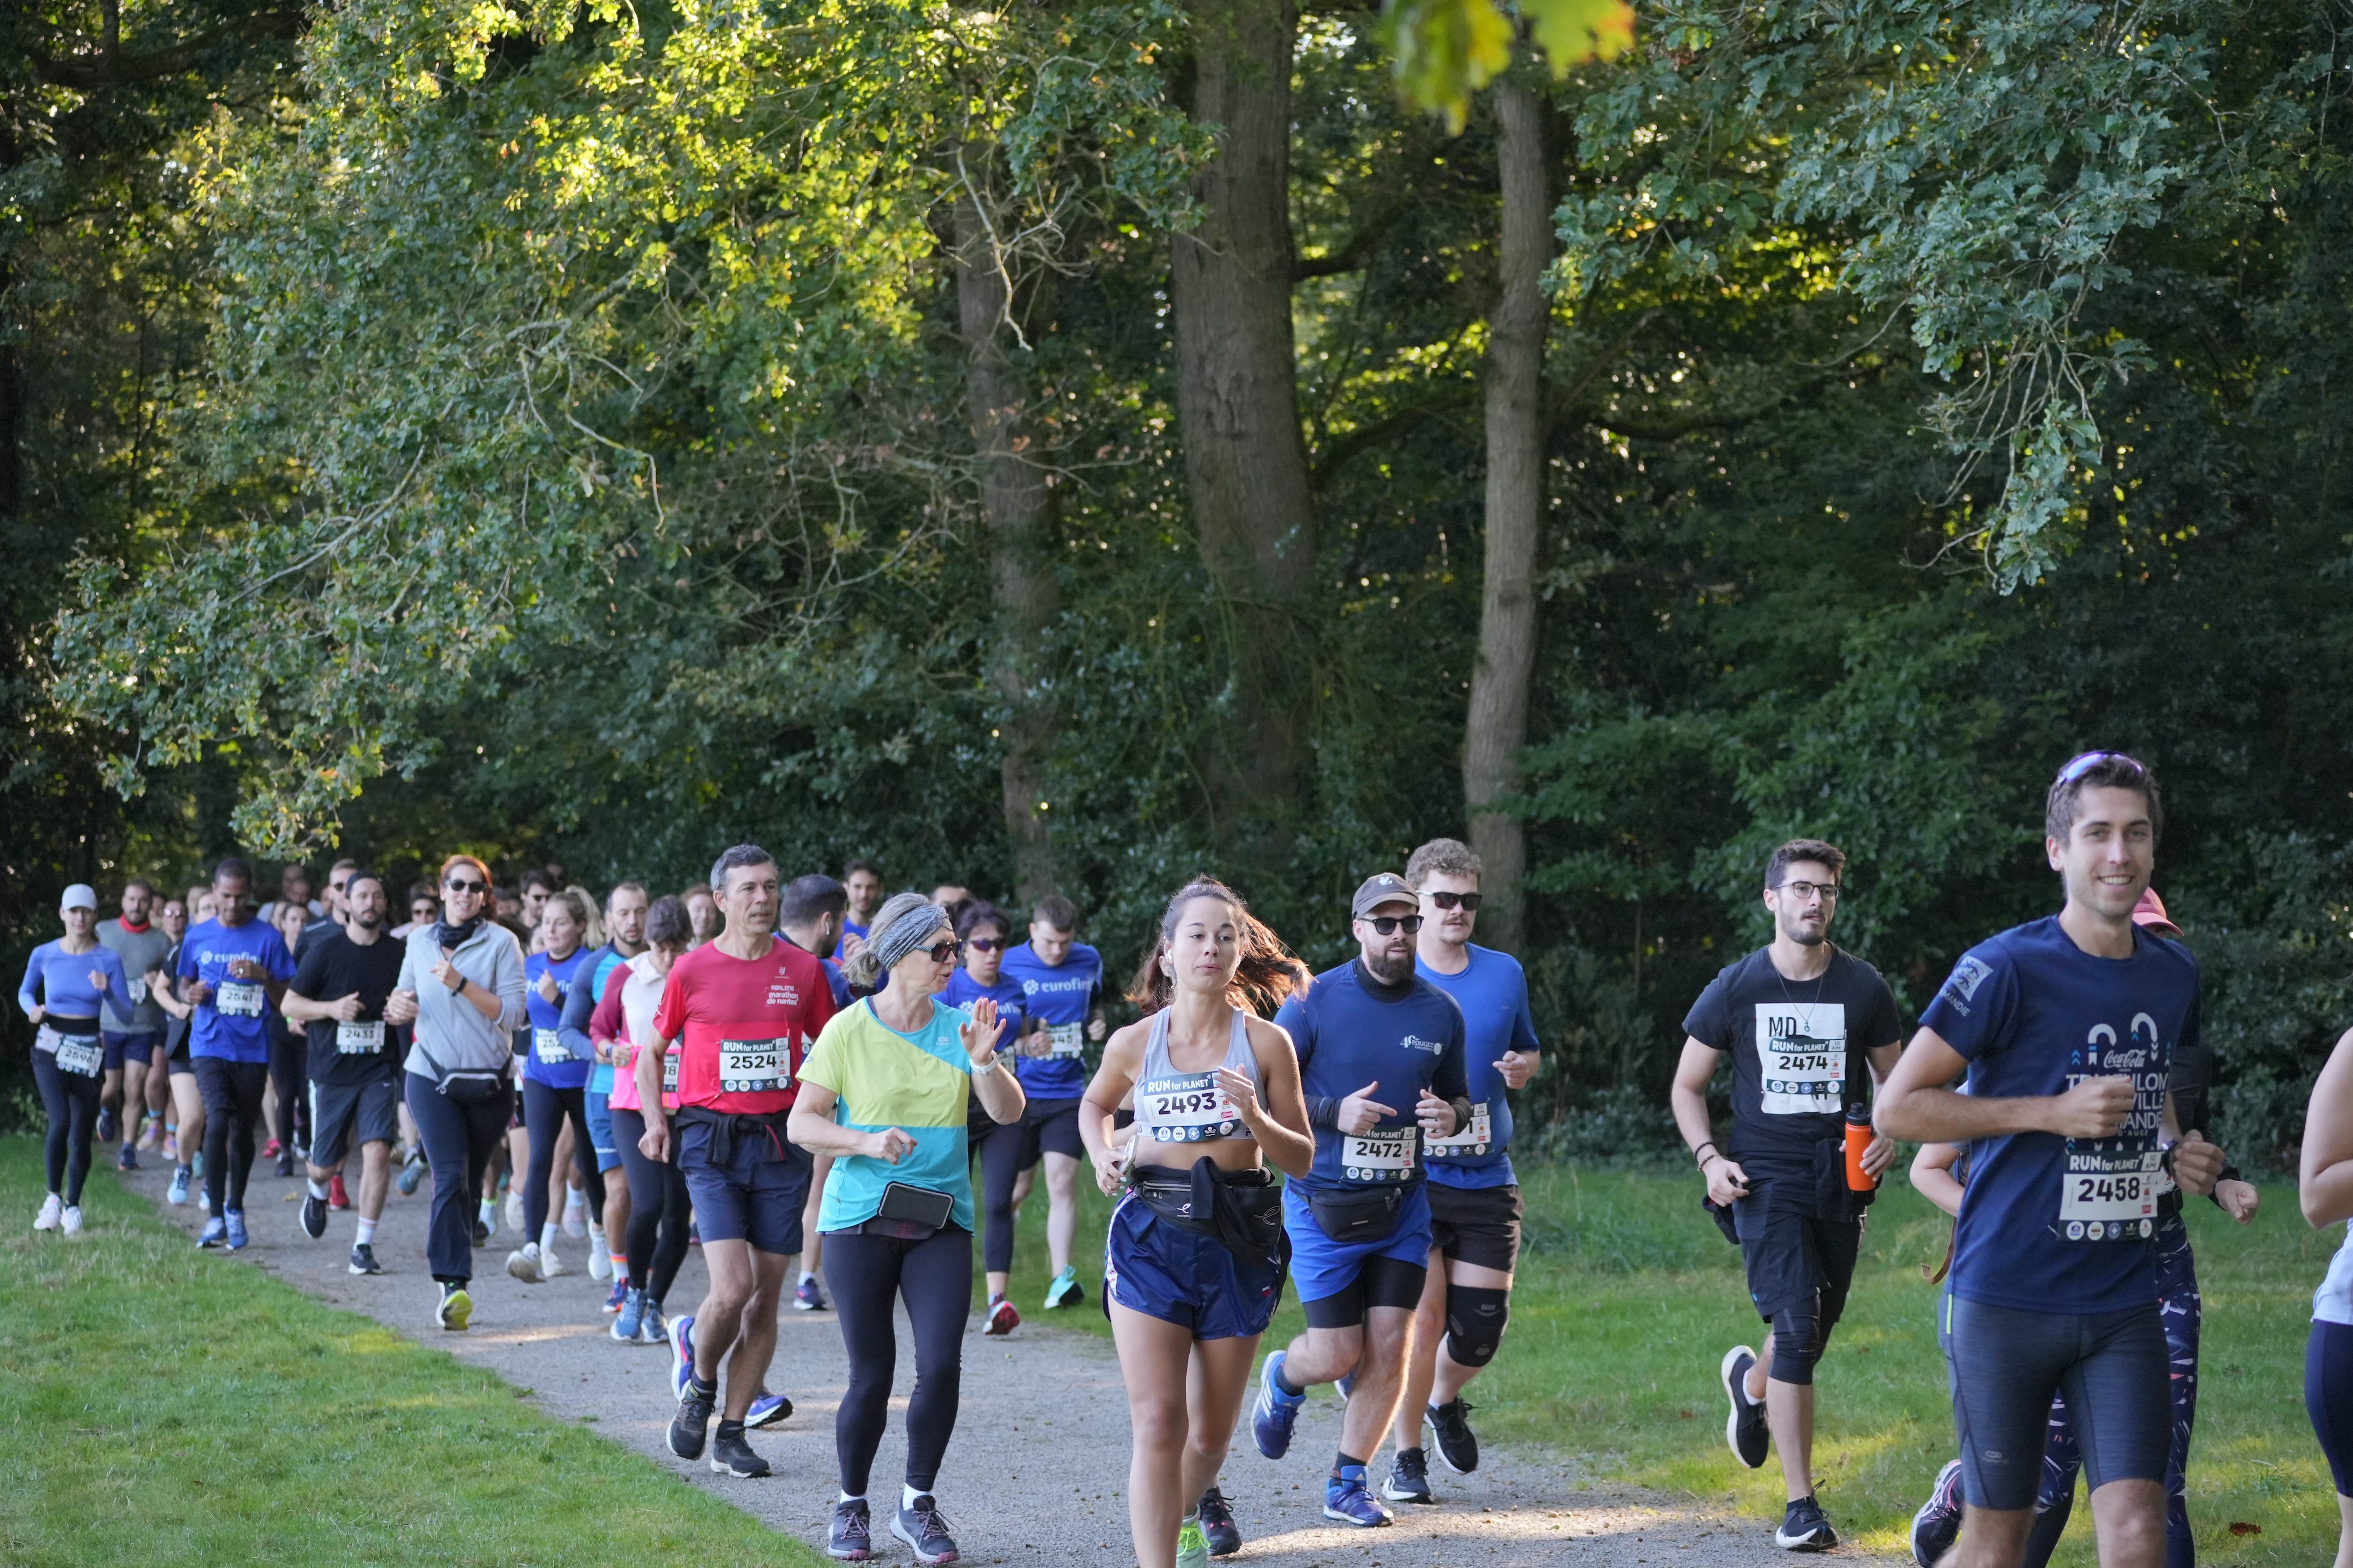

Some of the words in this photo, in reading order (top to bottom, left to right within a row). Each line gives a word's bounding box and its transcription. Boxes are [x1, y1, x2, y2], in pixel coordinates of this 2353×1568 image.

[768, 991, 798, 1001] marathon
[724, 1041, 743, 1052] RUN
[743, 1043, 752, 1052] for
[753, 1043, 773, 1051] PLANET
[1772, 1040, 1795, 1051] RUN
[730, 1055, 776, 1069] 2524
[1779, 1055, 1827, 1070] 2474
[1148, 1079, 1171, 1093] RUN
[1171, 1082, 1181, 1091] for
[1183, 1079, 1209, 1089] PLANET
[1156, 1092, 1217, 1115] 2493
[1356, 1141, 1402, 1157] 2472
[2070, 1155, 2101, 1171] RUN
[2101, 1160, 2112, 1170] for
[2114, 1159, 2139, 1170] PLANET
[2078, 1177, 2140, 1202] 2458
